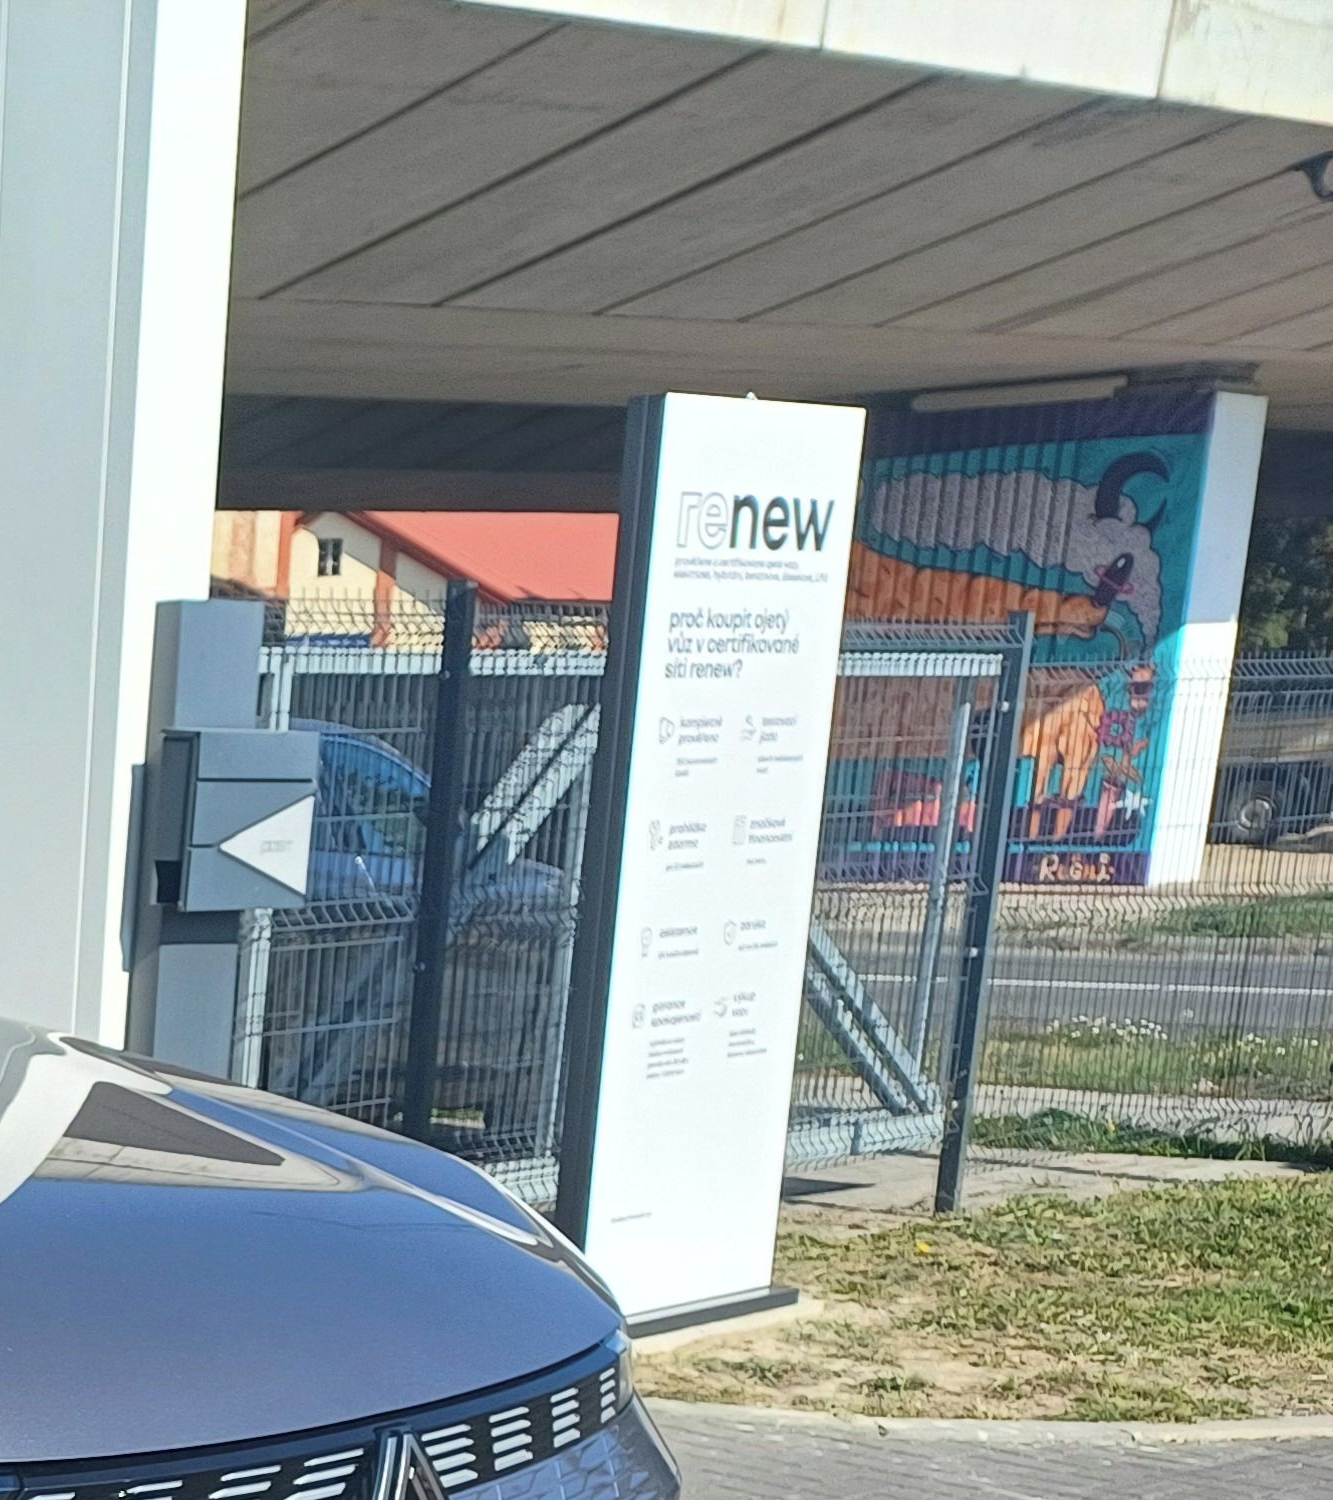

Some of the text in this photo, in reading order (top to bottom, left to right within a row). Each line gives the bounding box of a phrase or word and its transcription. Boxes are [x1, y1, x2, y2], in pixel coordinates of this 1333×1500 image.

[675, 491, 835, 552] renew
[669, 606, 790, 636] proč koupit ojetý
[667, 630, 800, 655] vůz v certifikované
[664, 657, 744, 679] síti renew?
